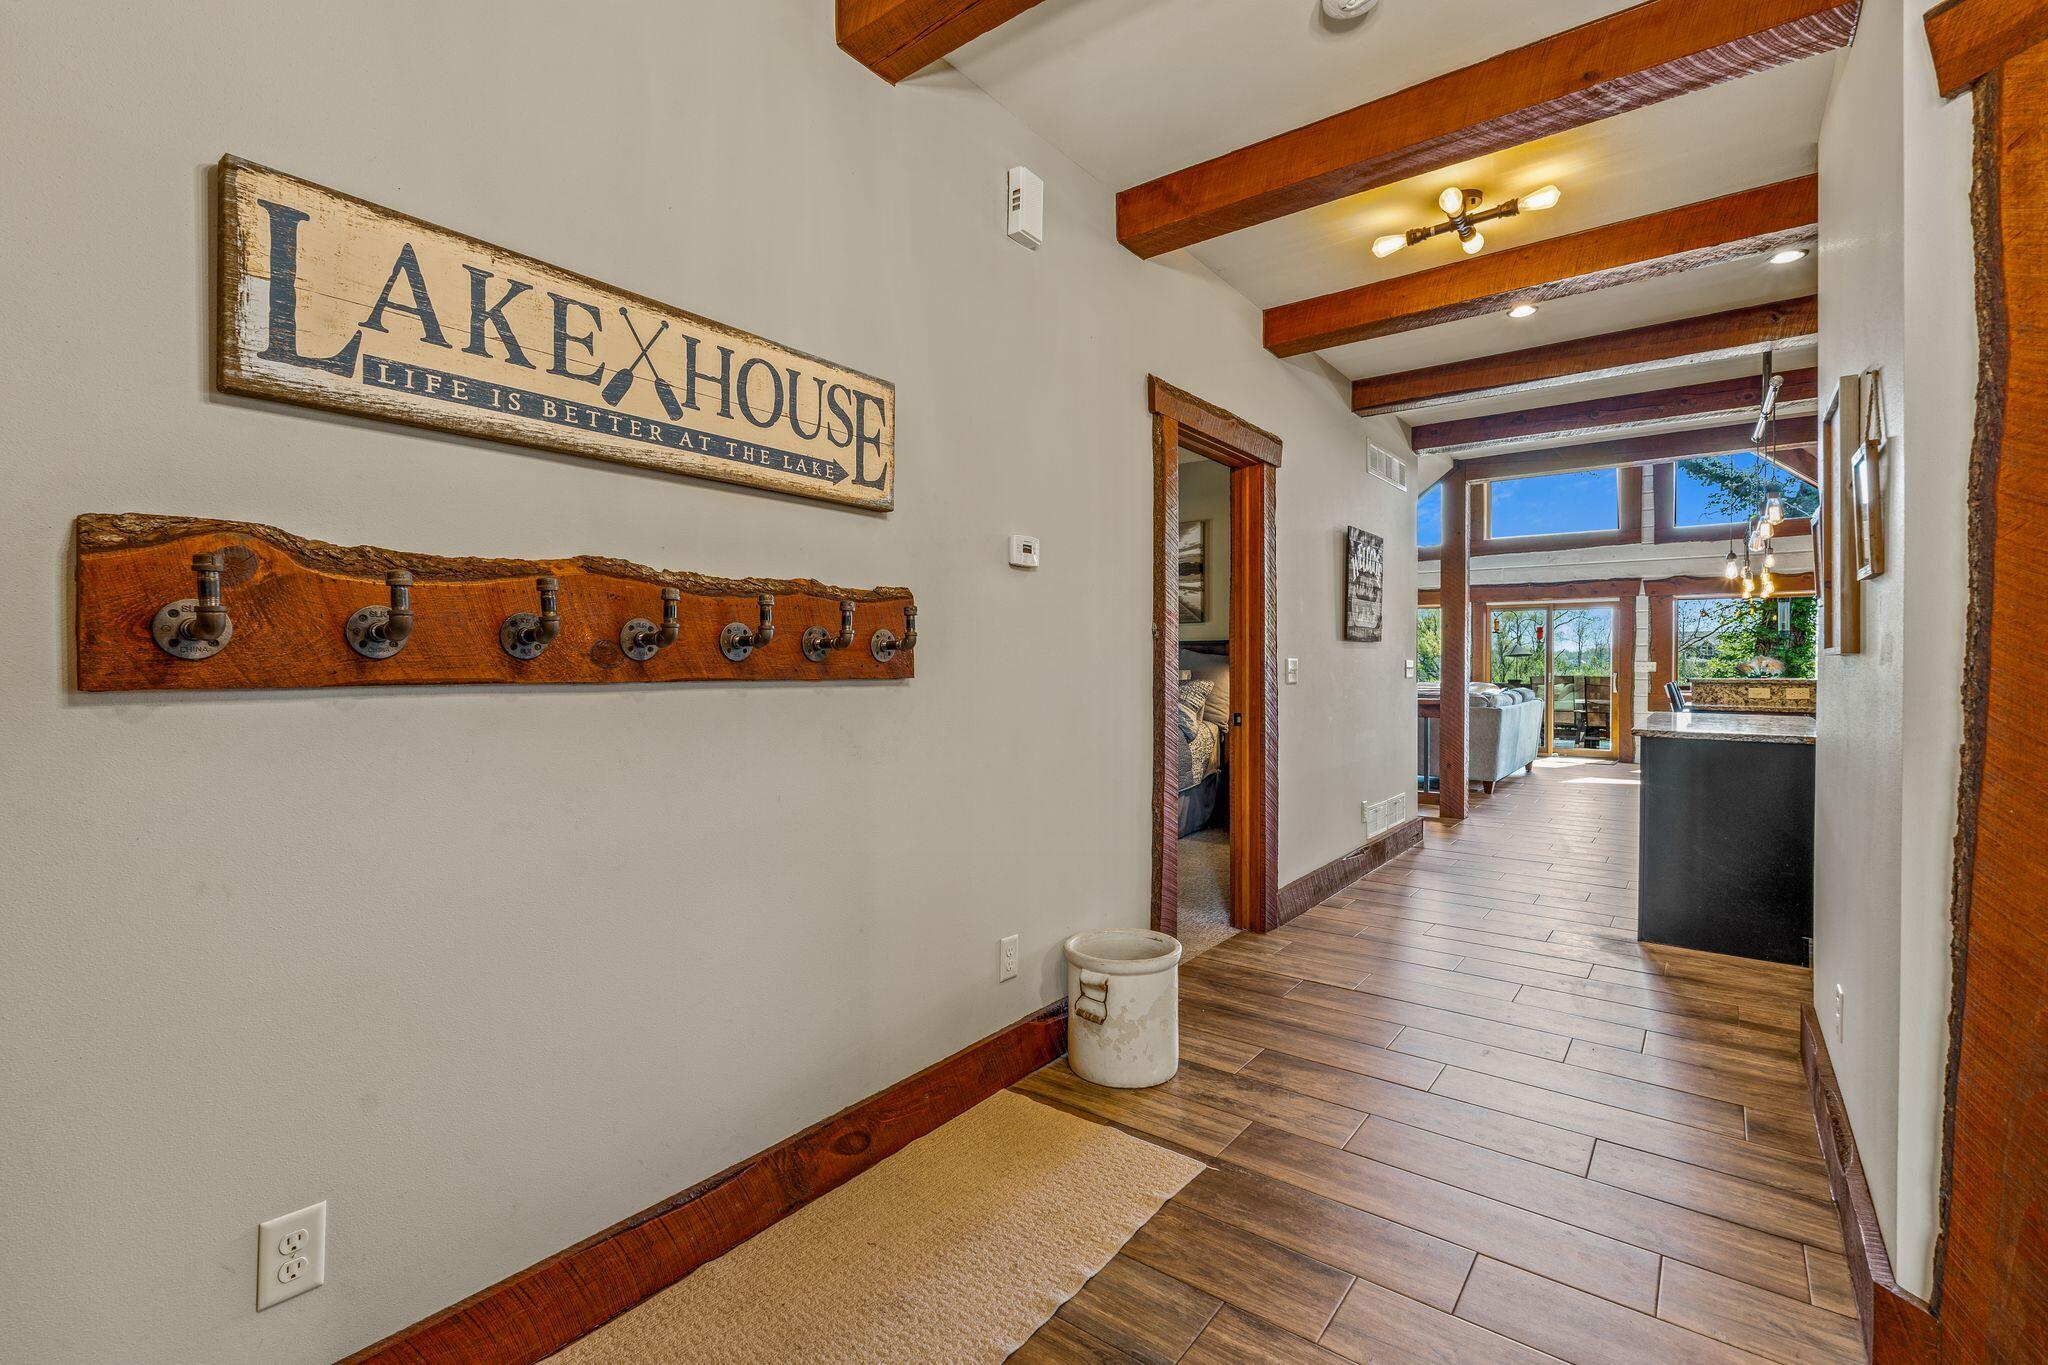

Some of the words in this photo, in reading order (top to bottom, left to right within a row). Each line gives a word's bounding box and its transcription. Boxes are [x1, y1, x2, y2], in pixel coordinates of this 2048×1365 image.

[257, 198, 606, 387] LAKE
[681, 333, 889, 491] HOUSE
[377, 364, 469, 401] LIFE
[491, 388, 522, 411] IS
[542, 399, 665, 442] BETTER
[678, 431, 711, 452] AT
[725, 441, 770, 465] THE
[782, 455, 836, 479] LAKE
[180, 645, 209, 654] CHINA
